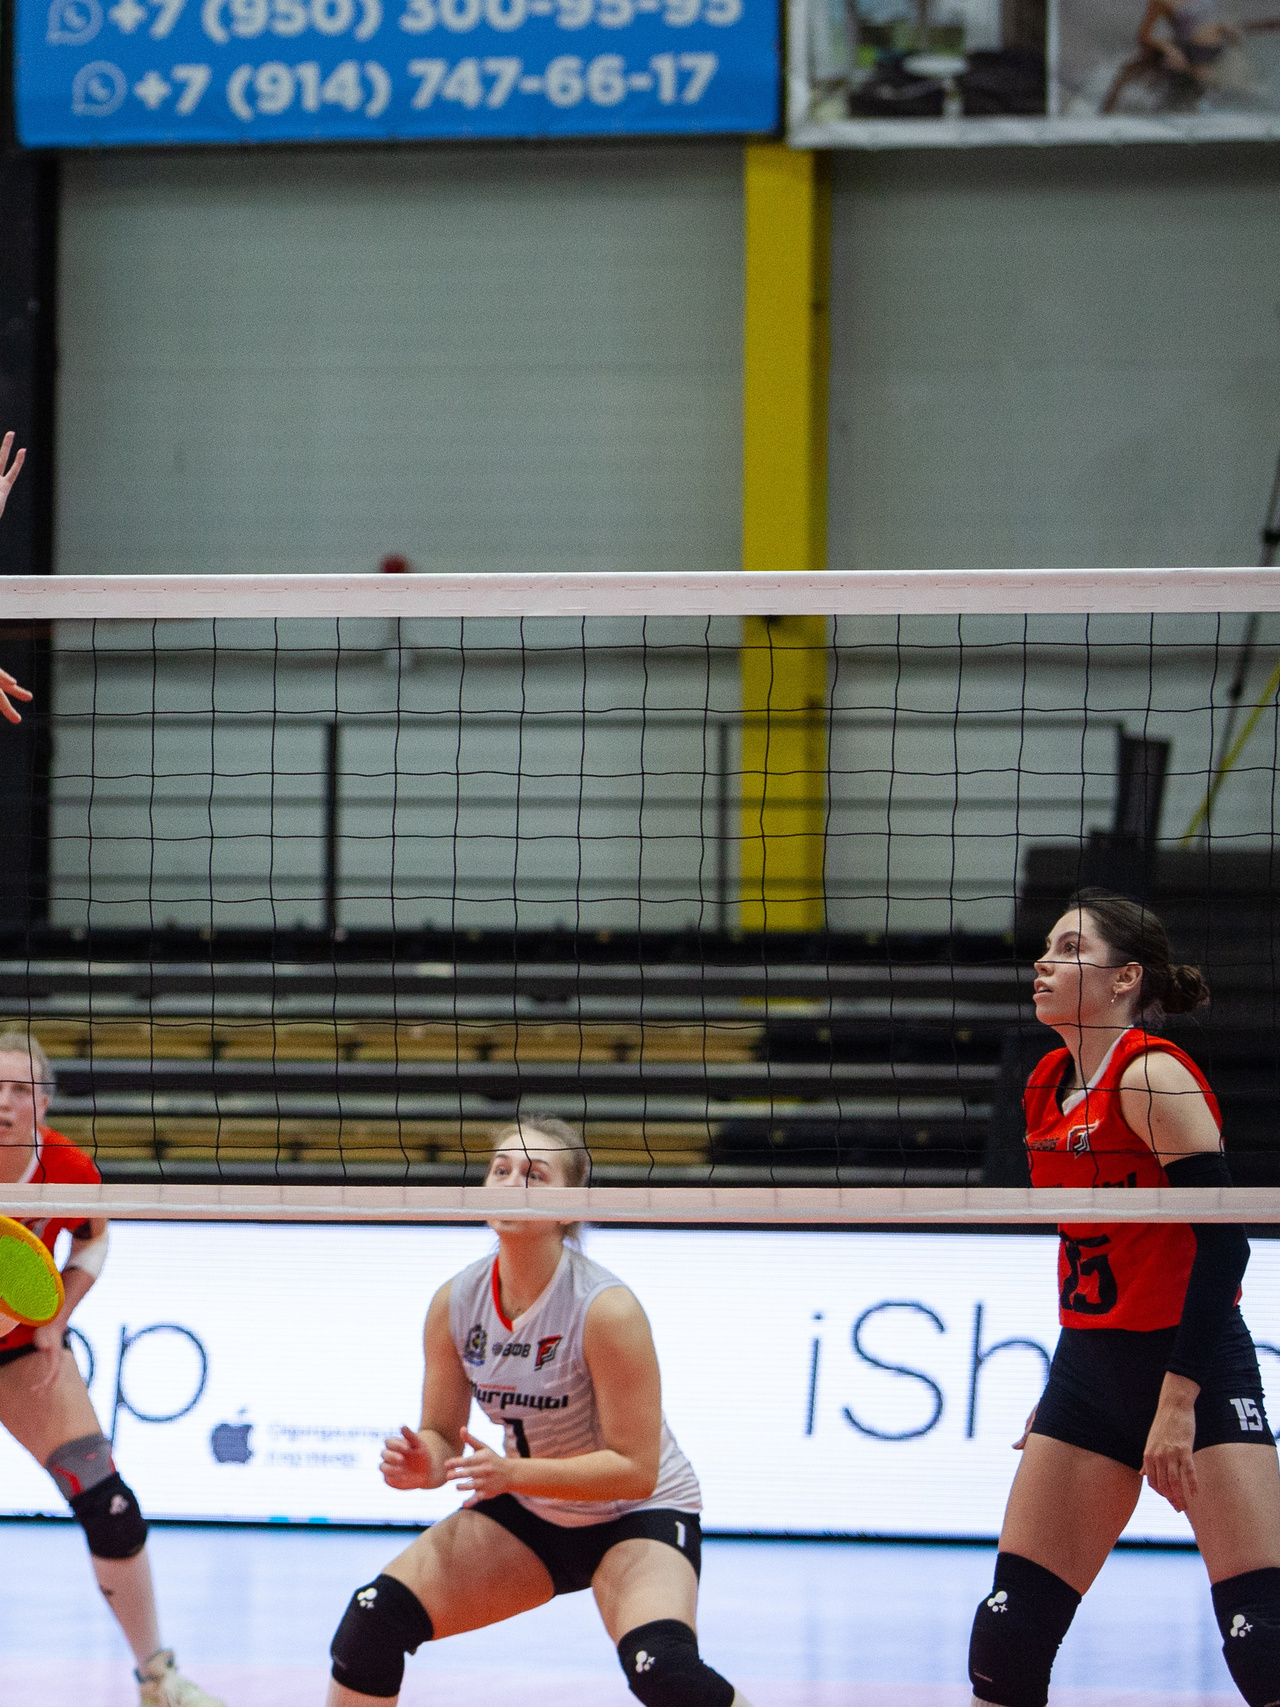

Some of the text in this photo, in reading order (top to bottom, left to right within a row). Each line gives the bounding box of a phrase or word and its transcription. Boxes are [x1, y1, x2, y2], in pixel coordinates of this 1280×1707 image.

[134, 52, 719, 122] +7 (914) 747-66-17
[803, 1299, 1054, 1441] iSh
[1229, 1397, 1264, 1431] 15
[675, 1520, 687, 1549] 1
